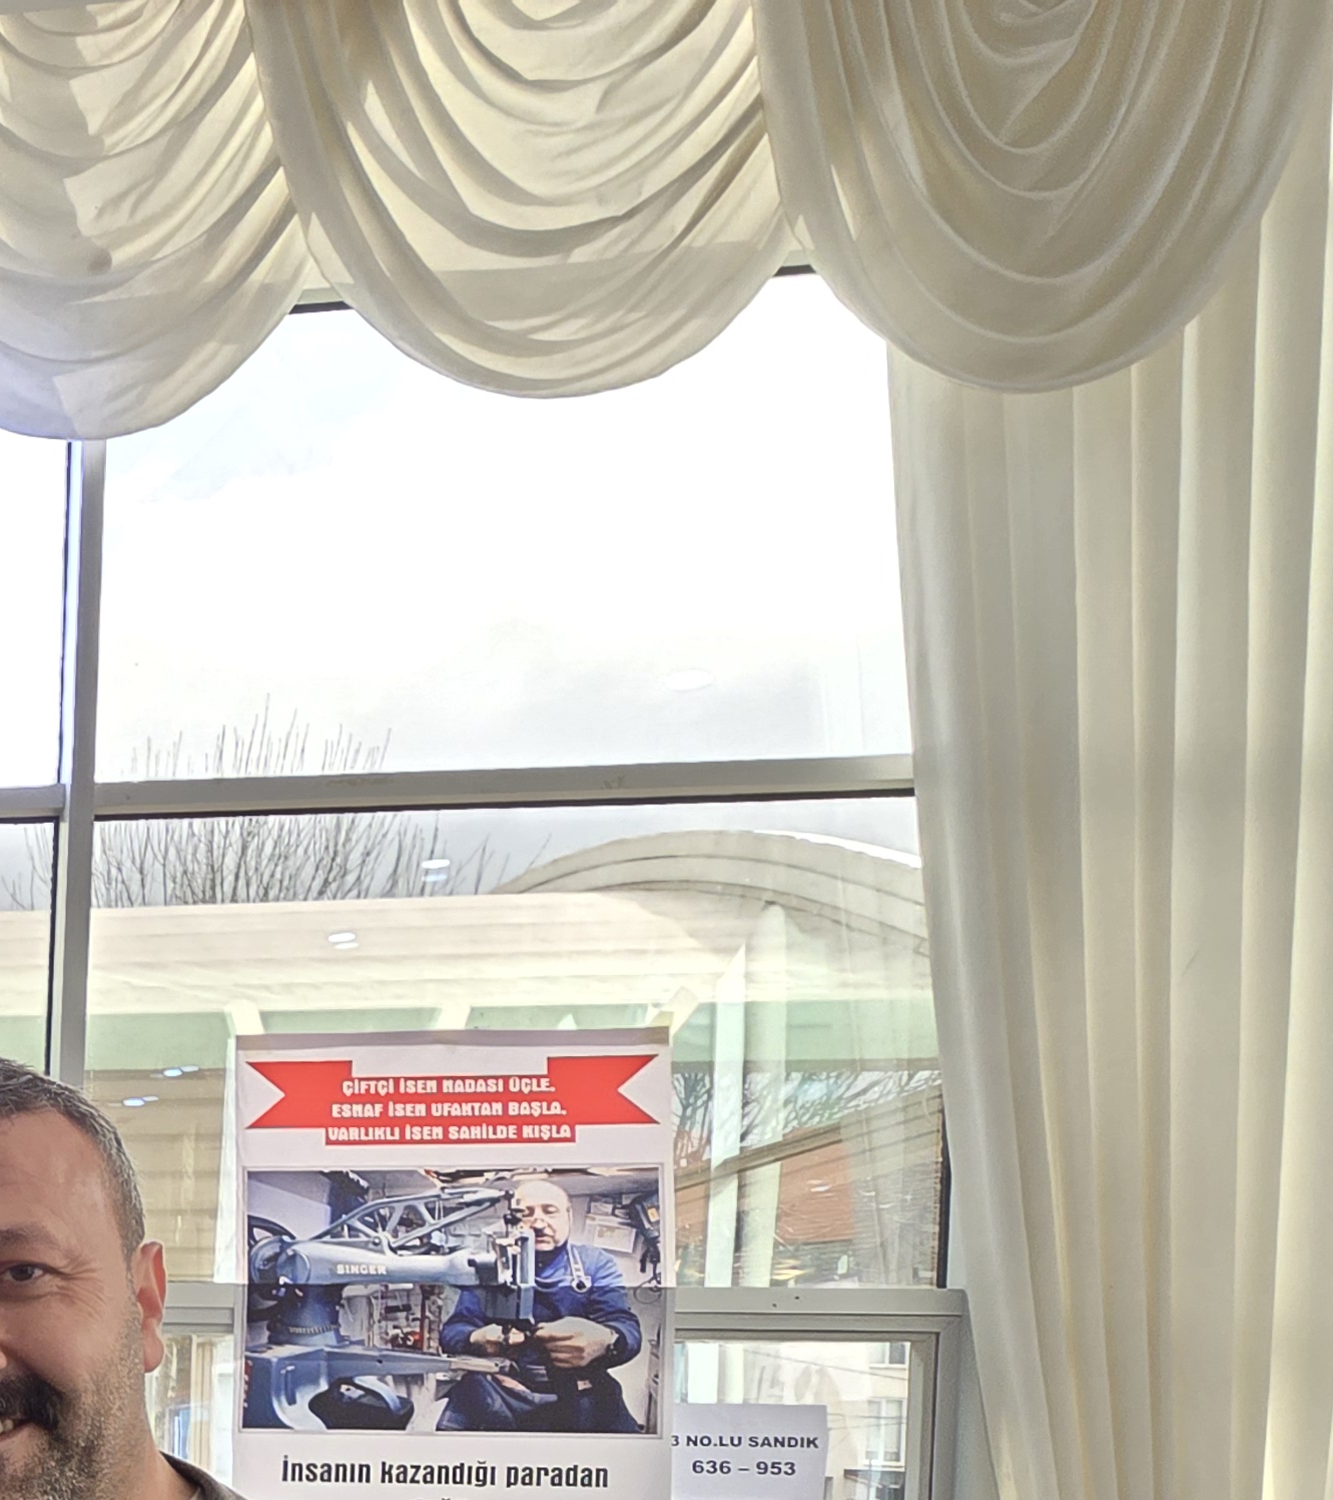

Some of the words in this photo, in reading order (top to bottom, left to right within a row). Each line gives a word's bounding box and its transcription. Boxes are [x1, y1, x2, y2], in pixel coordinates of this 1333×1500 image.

[399, 1077, 437, 1094] İSEN
[332, 1103, 383, 1118] ESNAF
[388, 1100, 427, 1117] İSEN
[404, 1123, 443, 1140] İSEN
[448, 1123, 518, 1139] SAHİLDE
[336, 1264, 387, 1275] SINGER
[671, 1435, 680, 1447] 3
[686, 1435, 742, 1447] NO.LU
[748, 1436, 819, 1449] SANDIK
[282, 1454, 371, 1483] İnsanın
[380, 1460, 496, 1487] kazandığı
[506, 1464, 608, 1488] paradan
[692, 1460, 732, 1475] 636
[756, 1461, 796, 1476] 953
